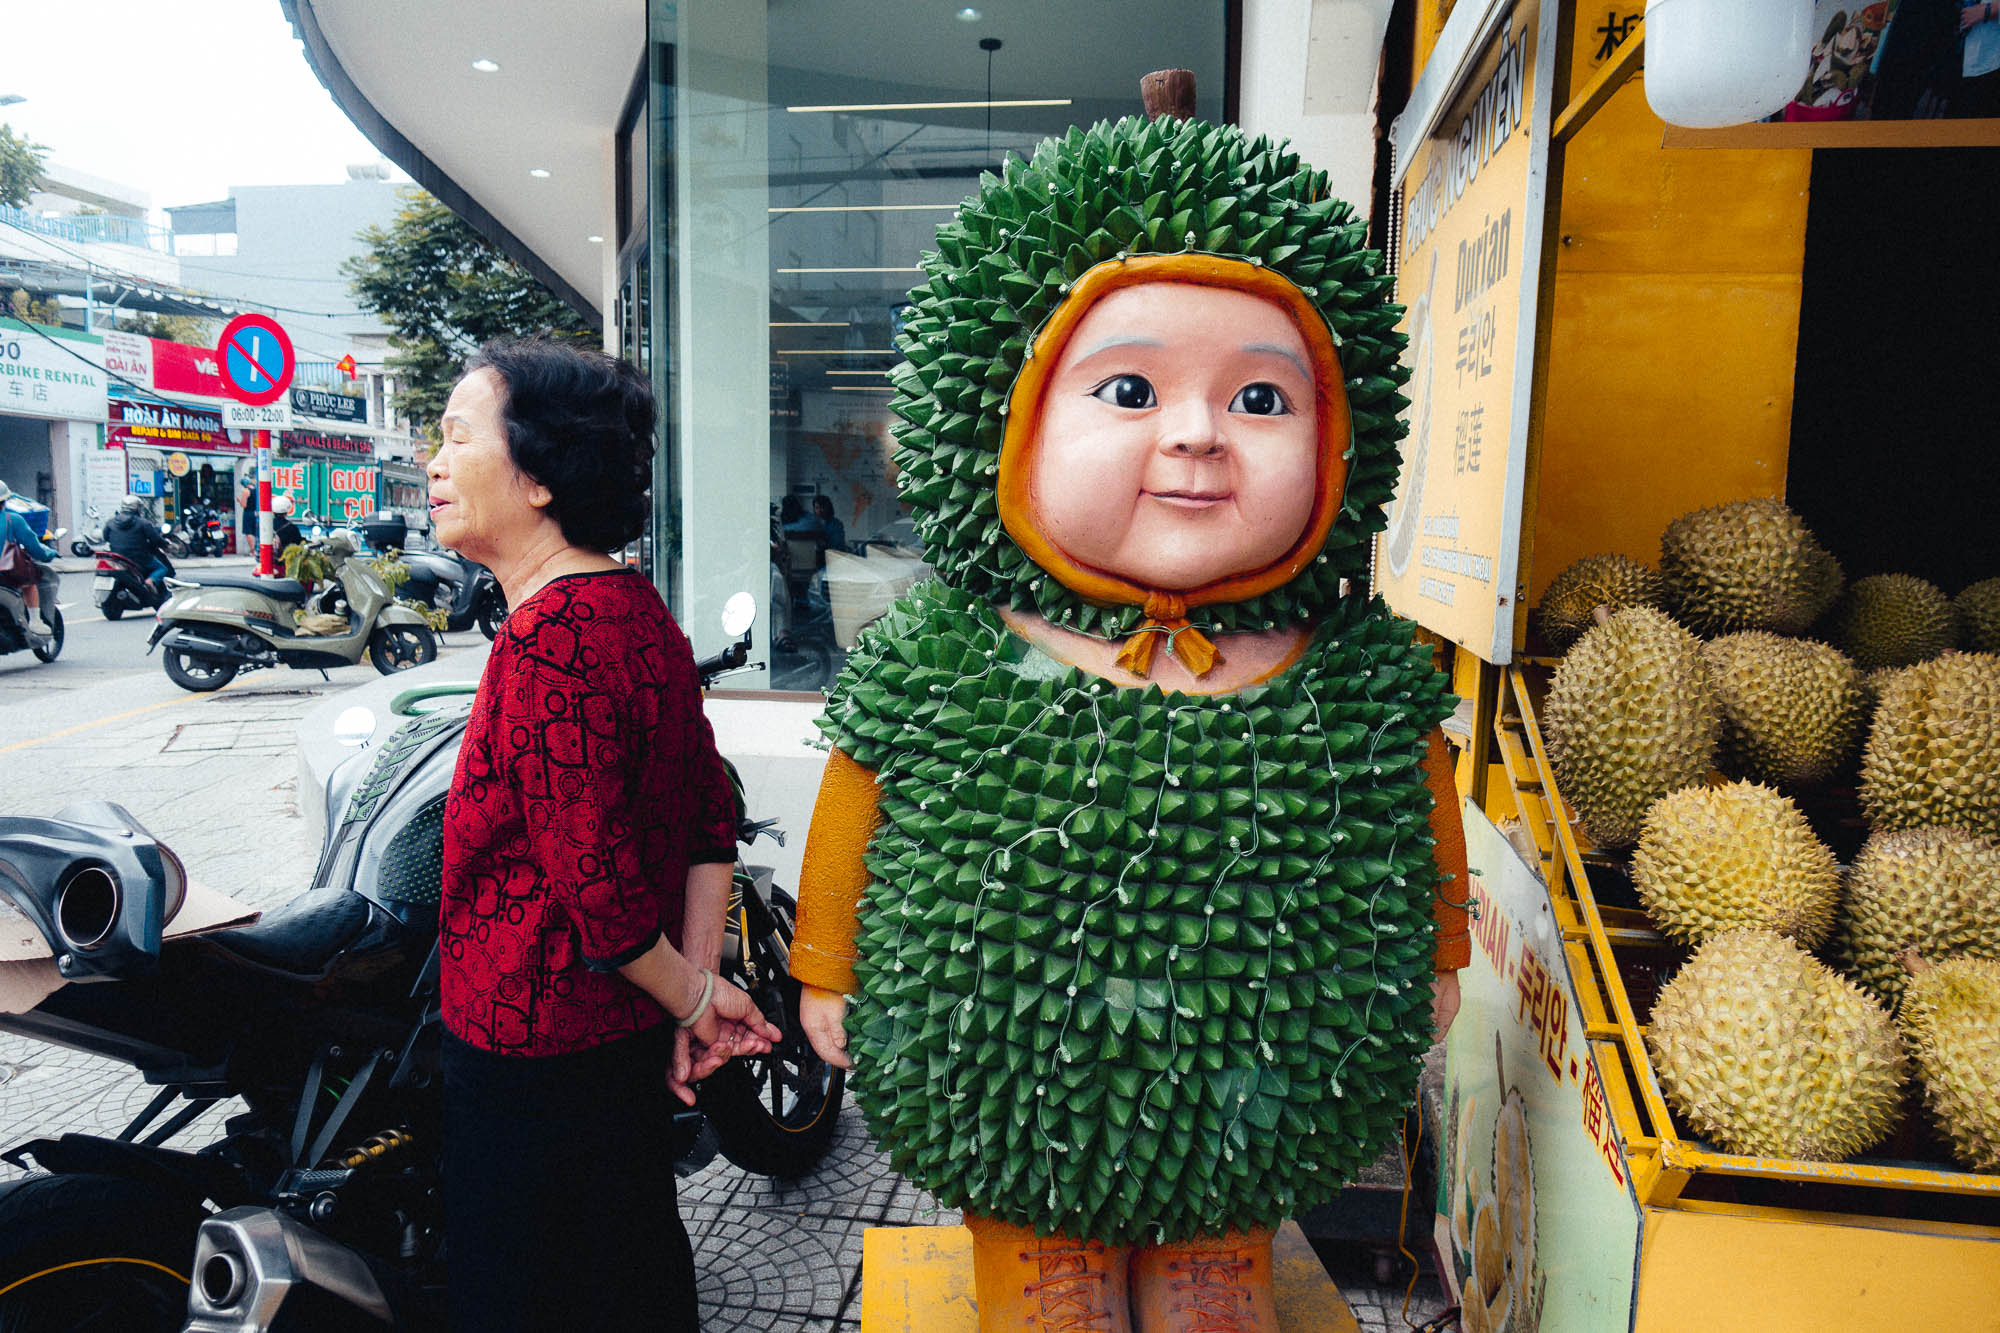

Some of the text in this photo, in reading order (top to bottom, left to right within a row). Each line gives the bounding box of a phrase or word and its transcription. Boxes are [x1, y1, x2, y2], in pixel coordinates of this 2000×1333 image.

[1454, 208, 1511, 314] Durian
[1456, 305, 1496, 389] 두리안
[45, 369, 96, 388] RENTAL
[310, 391, 336, 408] PHÚC
[123, 405, 219, 432] HOÀI ÂN Mobile
[231, 407, 255, 422] 06:00
[262, 408, 284, 423] 22:00
[305, 435, 326, 449] NAILS
[332, 438, 357, 452] BEAUTY
[359, 441, 371, 454] SPA
[331, 466, 375, 492] GIỚI
[1470, 877, 1509, 980] URIAN
[1517, 944, 1568, 1082] 두리안
